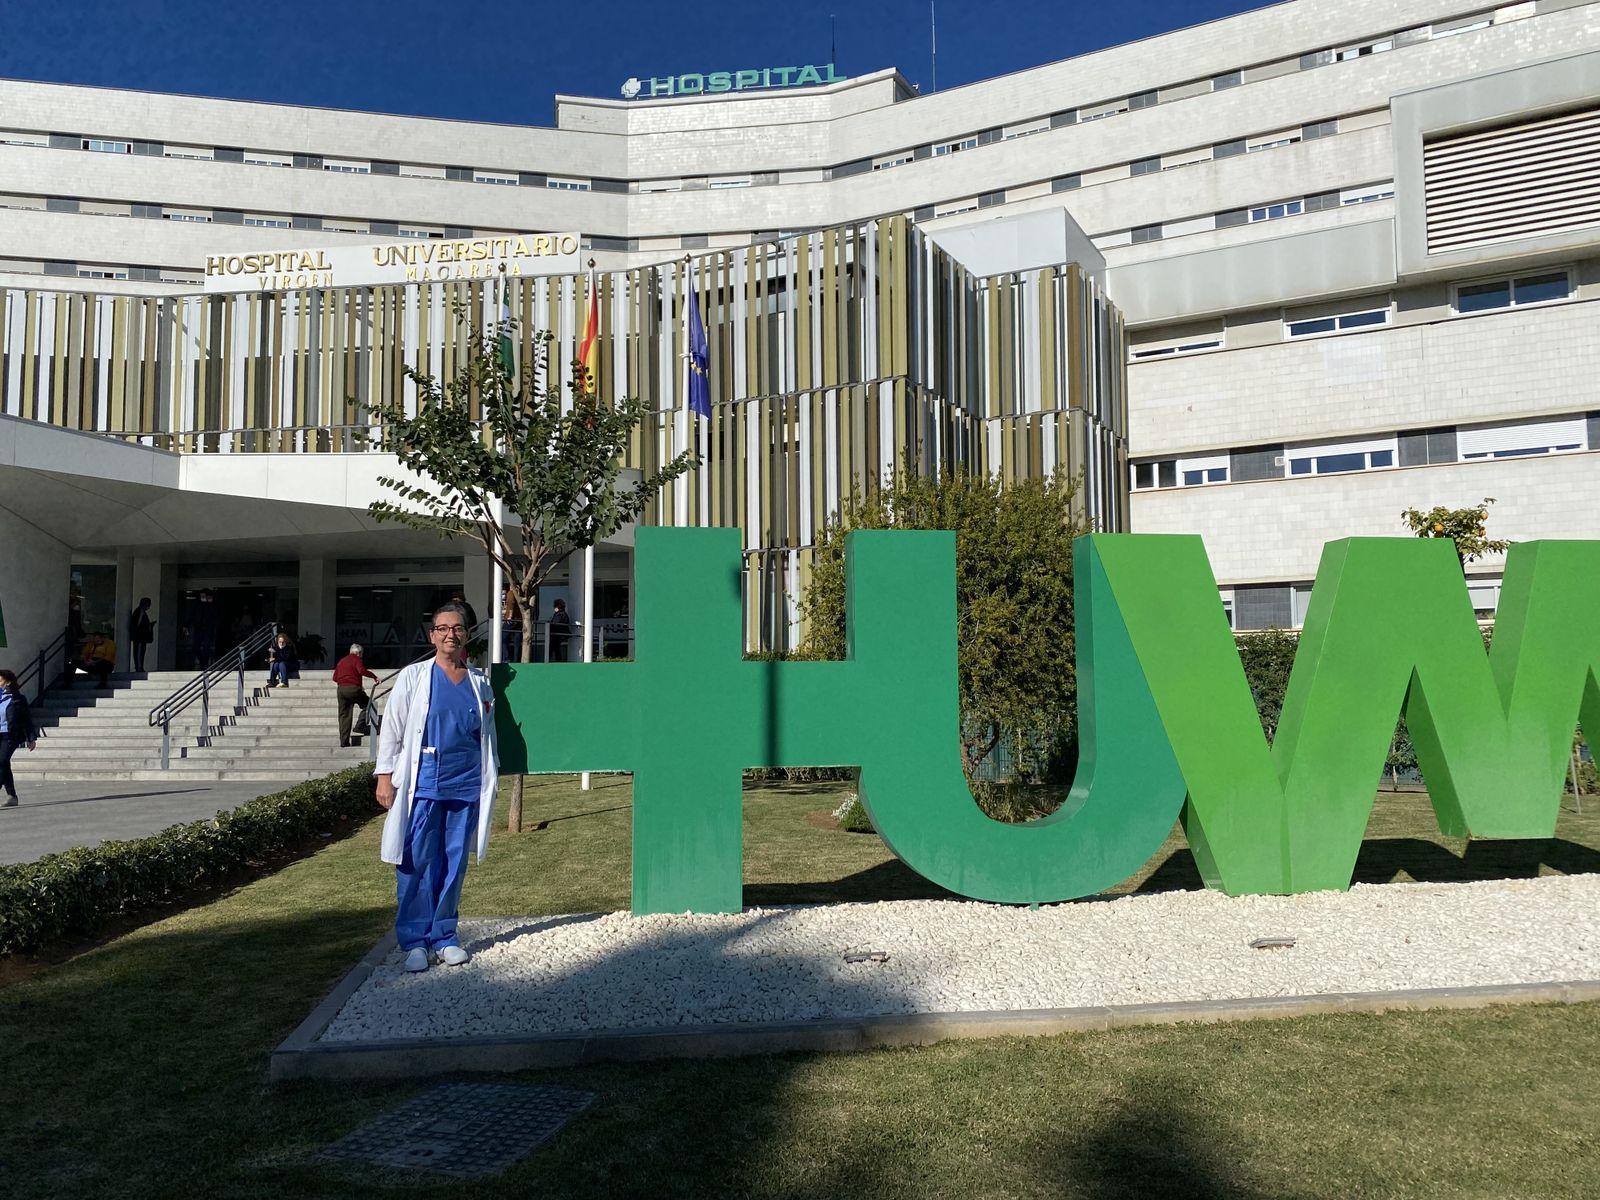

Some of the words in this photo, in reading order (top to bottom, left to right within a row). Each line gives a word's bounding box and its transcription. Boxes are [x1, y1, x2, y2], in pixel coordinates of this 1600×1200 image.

[650, 63, 847, 96] HOSPITAL
[206, 251, 332, 276] HOSPITAL
[373, 234, 579, 265] UNIVERSITARIO
[258, 273, 333, 290] VIRGEN
